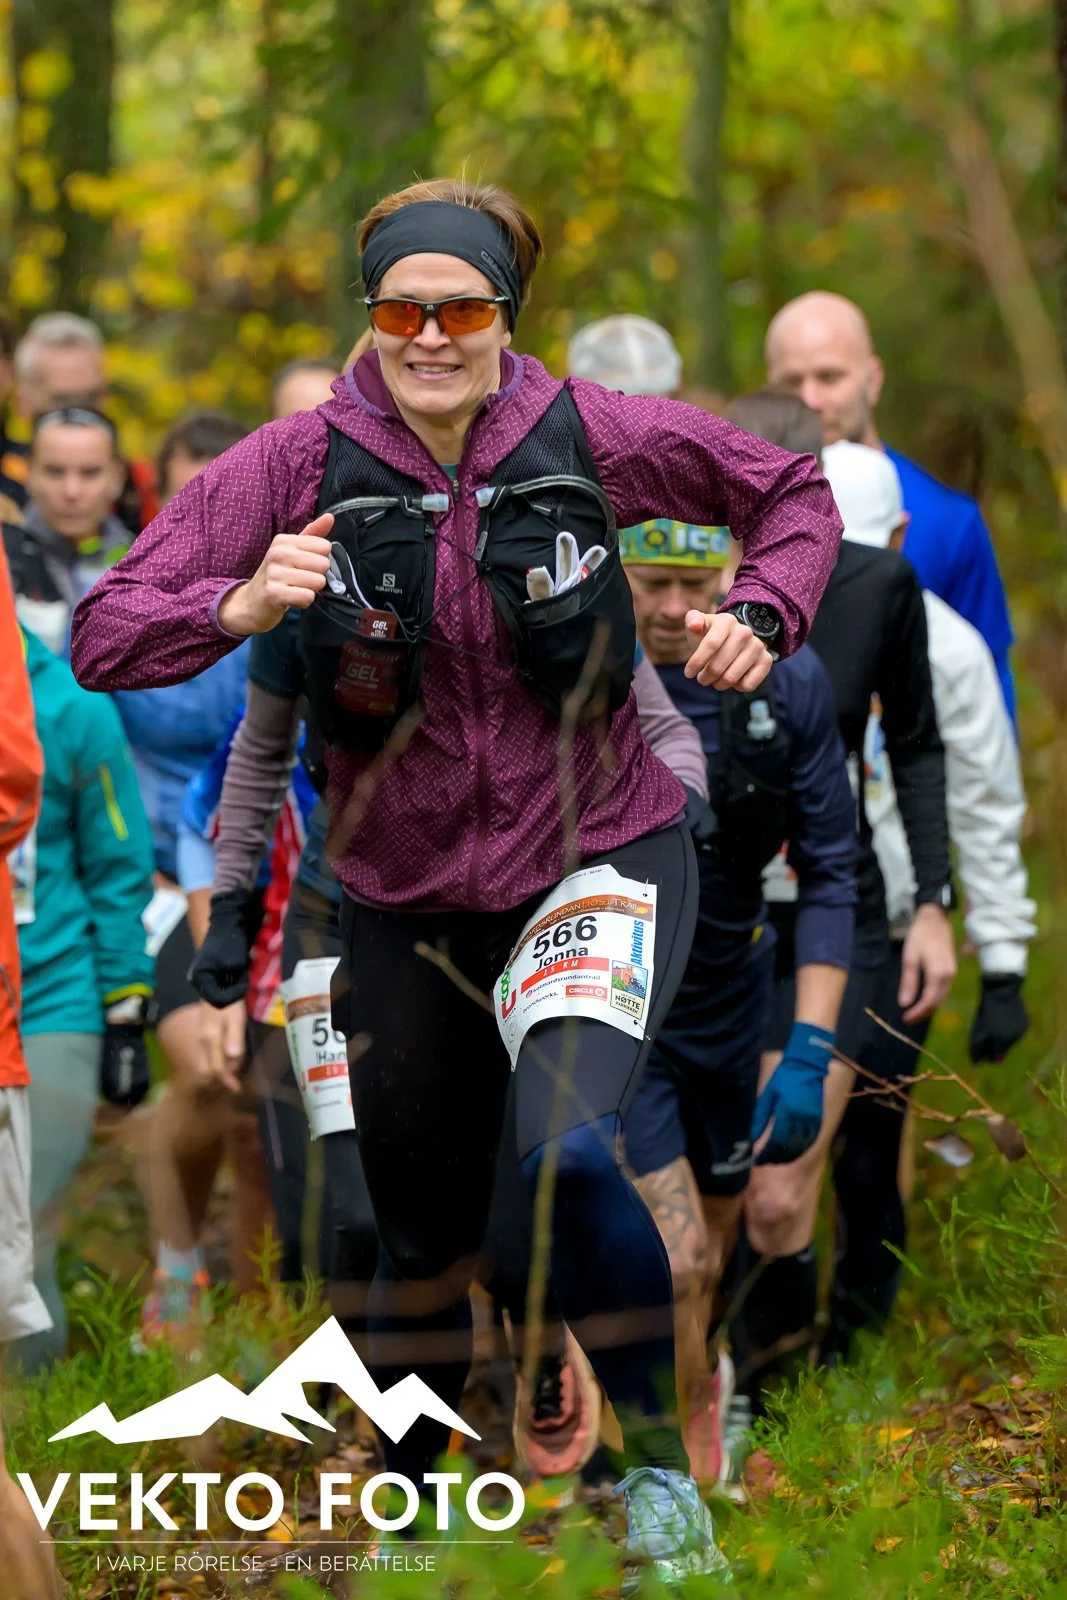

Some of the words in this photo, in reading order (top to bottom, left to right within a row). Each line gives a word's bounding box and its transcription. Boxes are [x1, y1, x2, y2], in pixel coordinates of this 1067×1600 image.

[372, 620, 388, 630] GEL
[345, 662, 379, 682] GEL
[533, 915, 598, 959] 566
[630, 920, 644, 966] Aktivitus
[535, 945, 589, 972] Jonna
[614, 994, 641, 1010] NØTTE
